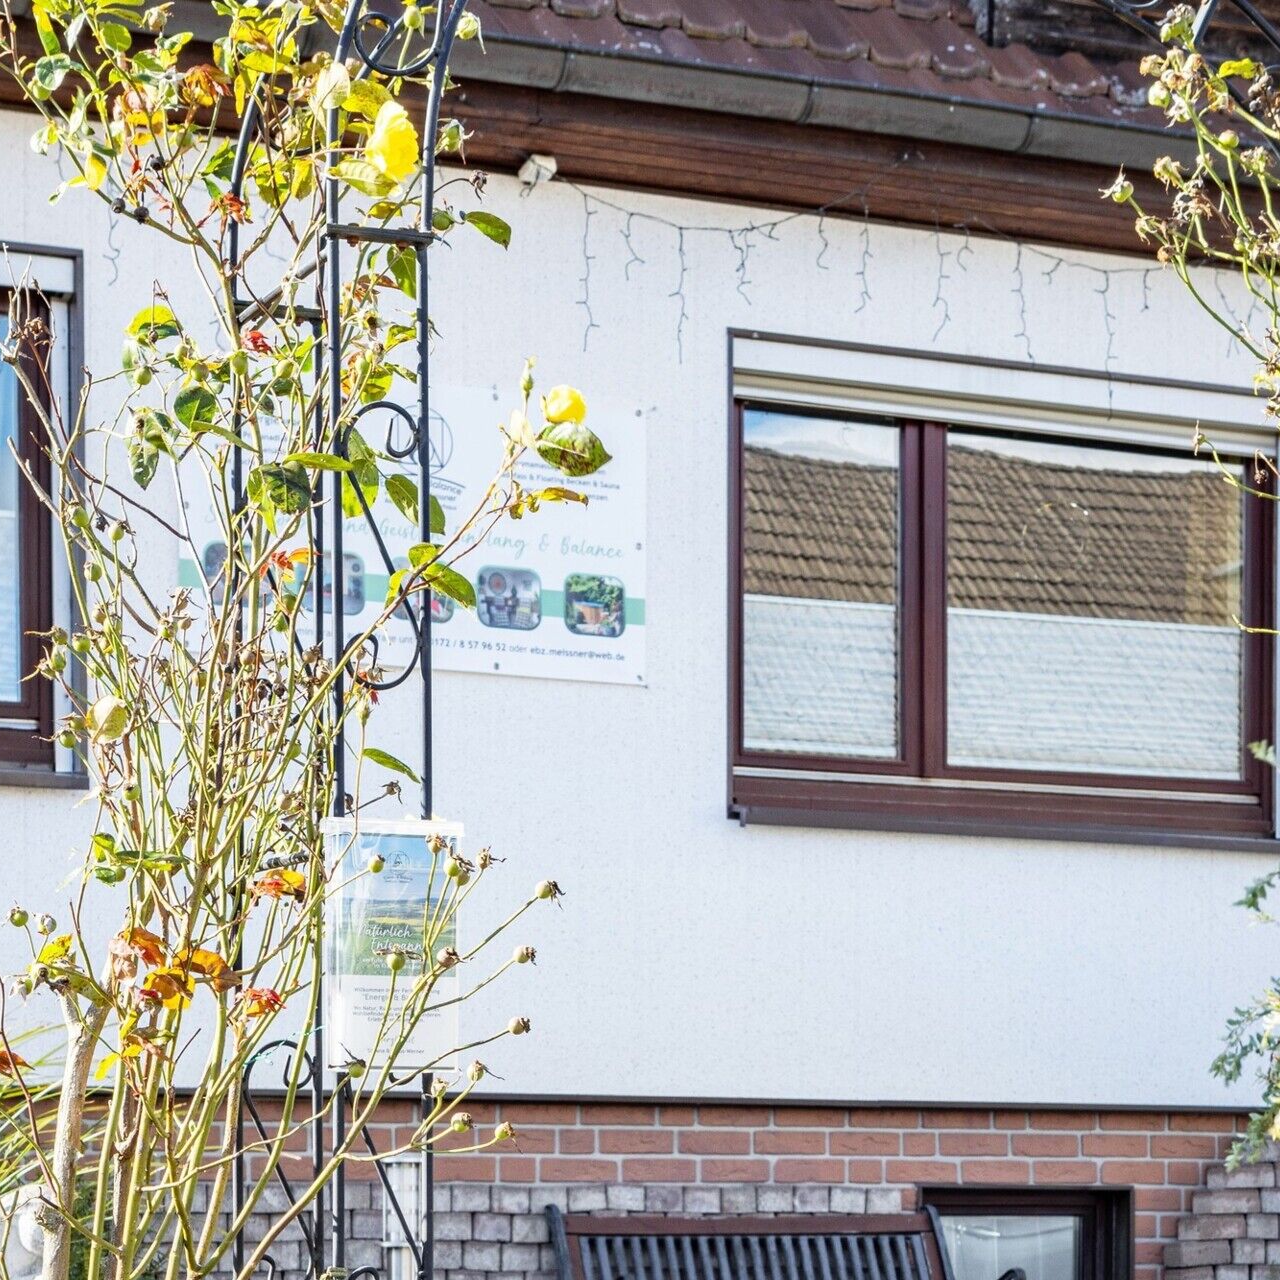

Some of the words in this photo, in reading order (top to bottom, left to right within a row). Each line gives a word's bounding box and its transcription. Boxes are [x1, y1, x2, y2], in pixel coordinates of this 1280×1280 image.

[430, 481, 463, 495] alance
[536, 474, 565, 485] Floating
[599, 481, 621, 490] Sauna
[559, 536, 626, 559] Balance
[431, 638, 450, 648] 172
[468, 640, 479, 650] 57
[481, 641, 493, 651] 96
[495, 642, 507, 652] 52
